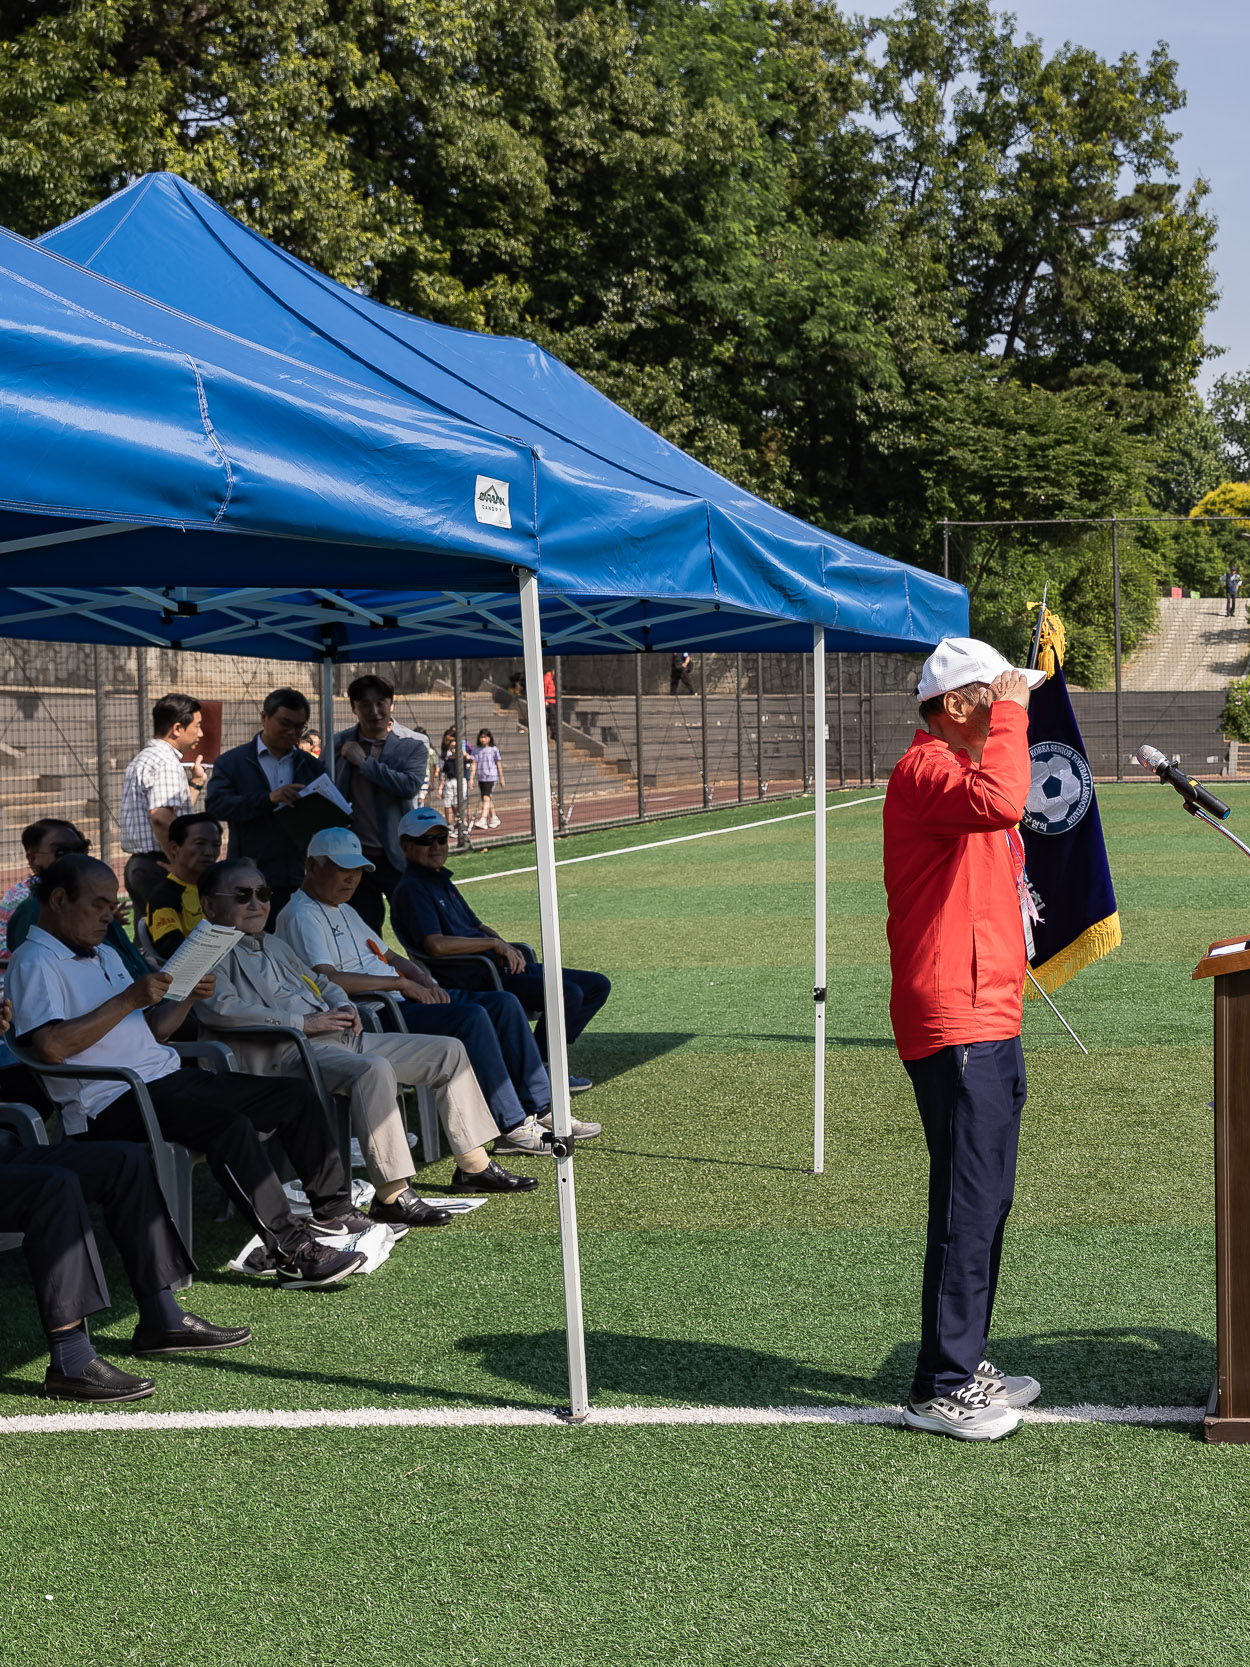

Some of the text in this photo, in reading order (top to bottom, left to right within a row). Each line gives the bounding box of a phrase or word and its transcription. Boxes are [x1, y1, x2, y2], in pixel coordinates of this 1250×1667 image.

[1029, 744, 1051, 758] KOREA
[1051, 744, 1073, 758] SENIOR
[1071, 754, 1090, 786] FOOTBALL
